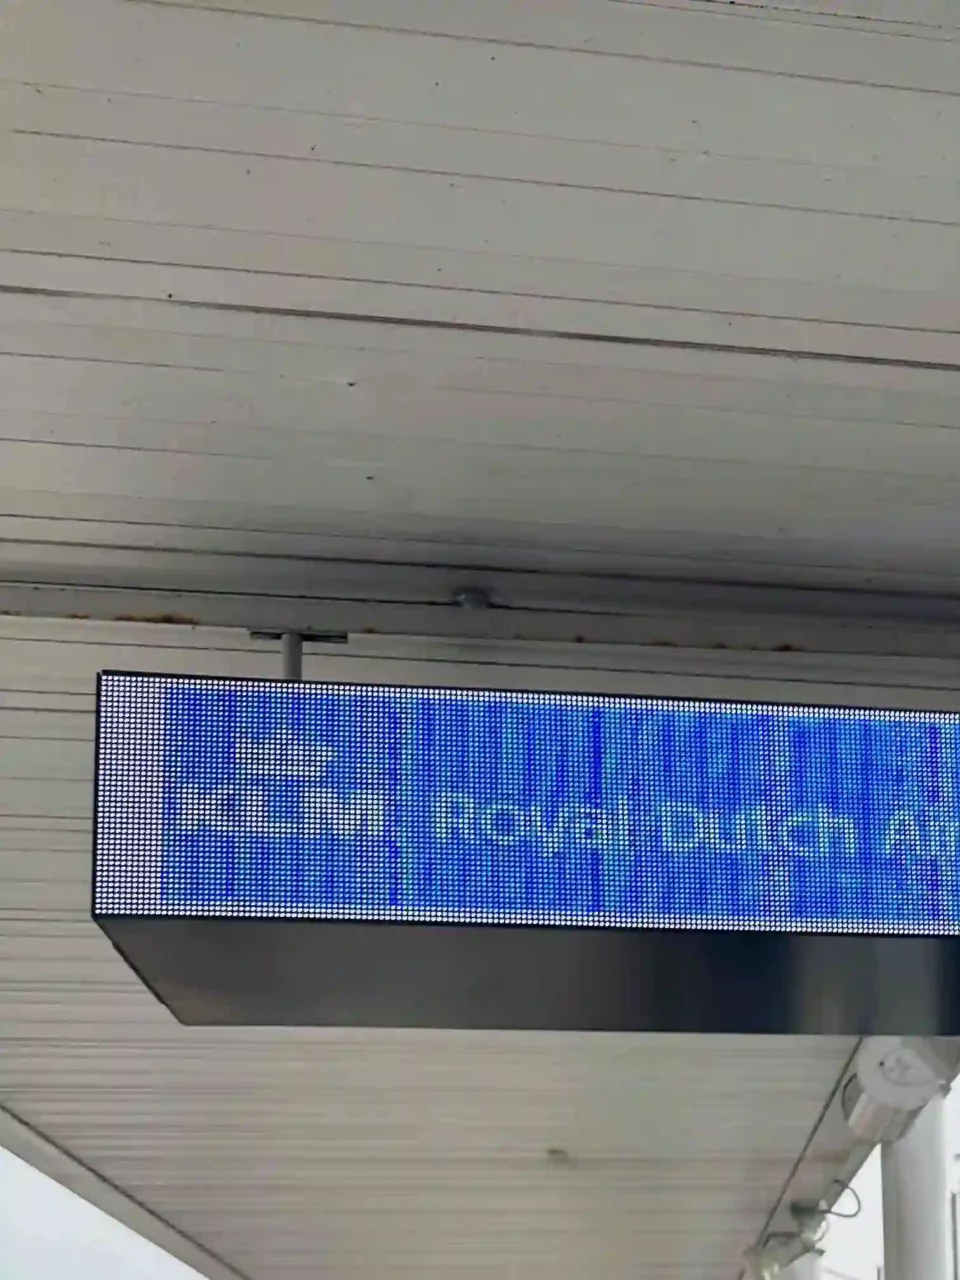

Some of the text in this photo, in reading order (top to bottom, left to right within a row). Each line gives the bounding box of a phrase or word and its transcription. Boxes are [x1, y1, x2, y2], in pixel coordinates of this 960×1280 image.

[178, 782, 384, 839] KLM
[431, 793, 630, 858] Royal
[660, 801, 857, 856] Dutch
